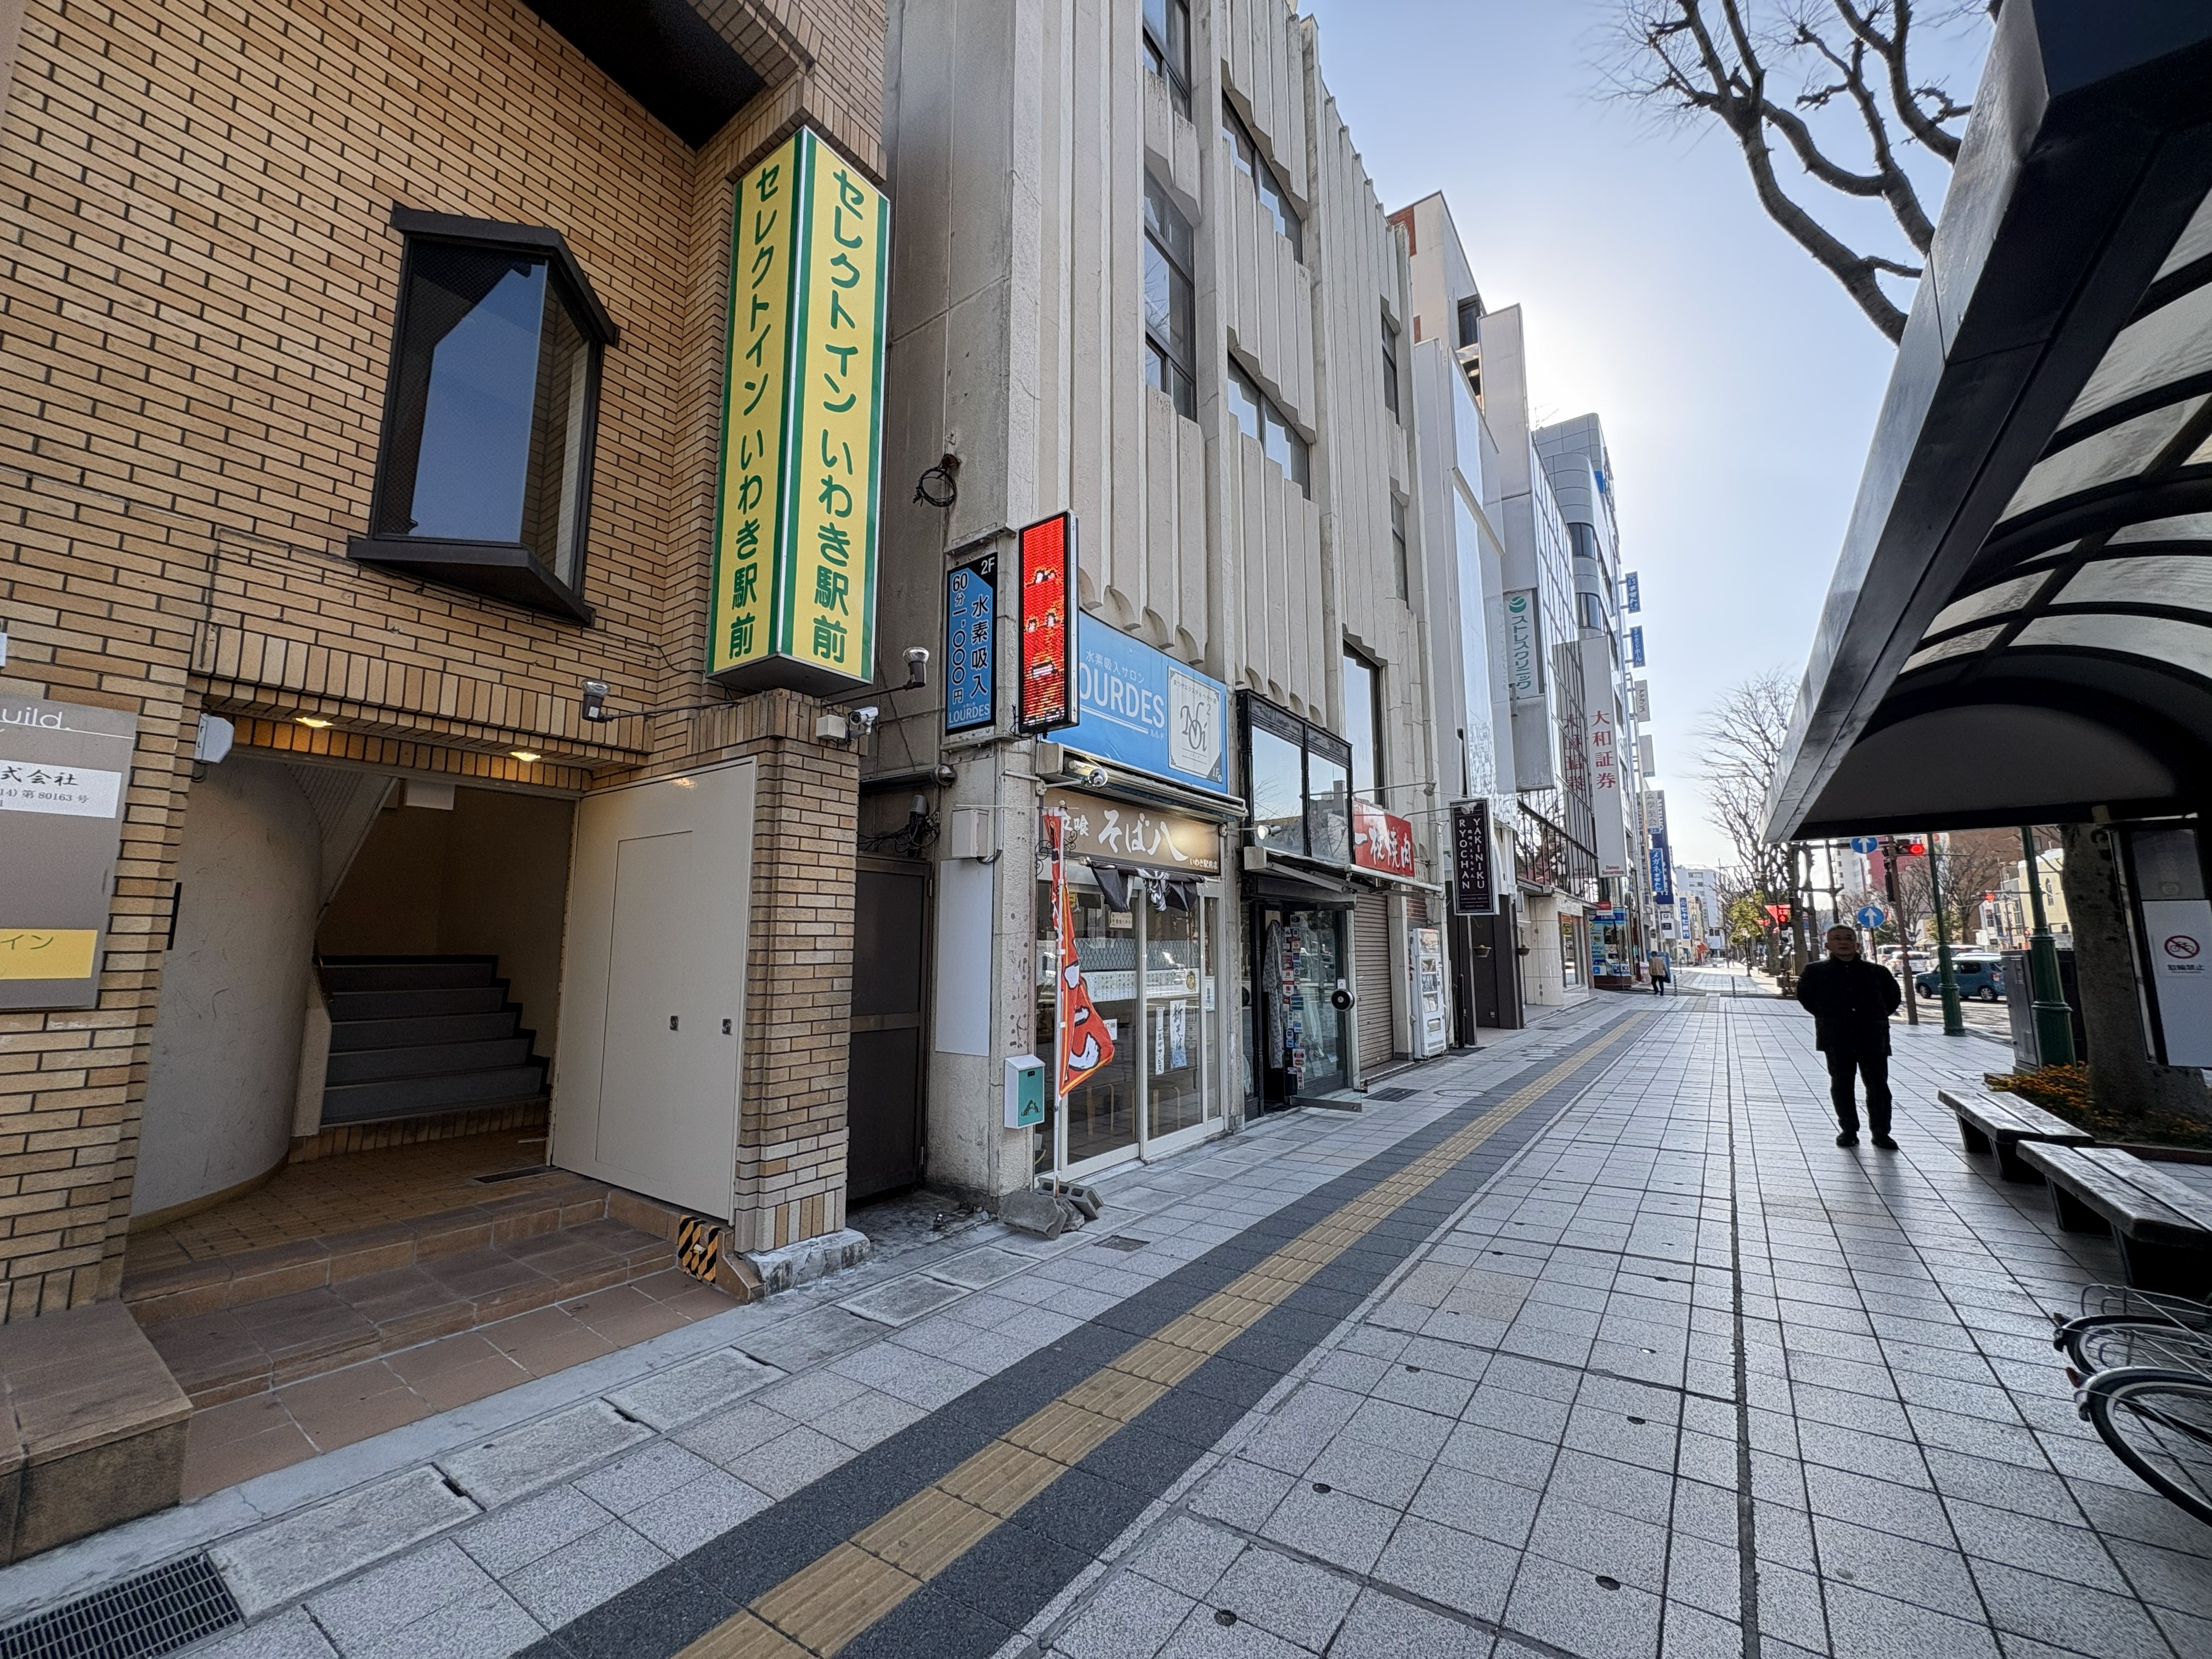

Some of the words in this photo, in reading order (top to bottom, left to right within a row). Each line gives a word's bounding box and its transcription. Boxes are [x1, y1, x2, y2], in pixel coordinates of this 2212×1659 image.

[981, 557, 995, 575] 2F
[970, 594, 989, 699] 水素吸入
[1086, 649, 1144, 684] 水素吸入サロン
[1511, 615, 1531, 690] ストレスクリニック
[949, 703, 990, 724] LOURDES
[1080, 662, 1165, 729] OURDES
[1590, 710, 1616, 789] 大和証券
[0, 766, 79, 787] 式会社
[38, 792, 72, 802] 80163
[1098, 809, 1188, 861] そば八
[1459, 819, 1470, 889] RYOCHAN
[1473, 817, 1485, 889] YAKINIKU
[1189, 858, 1218, 870] いわき駅前店
